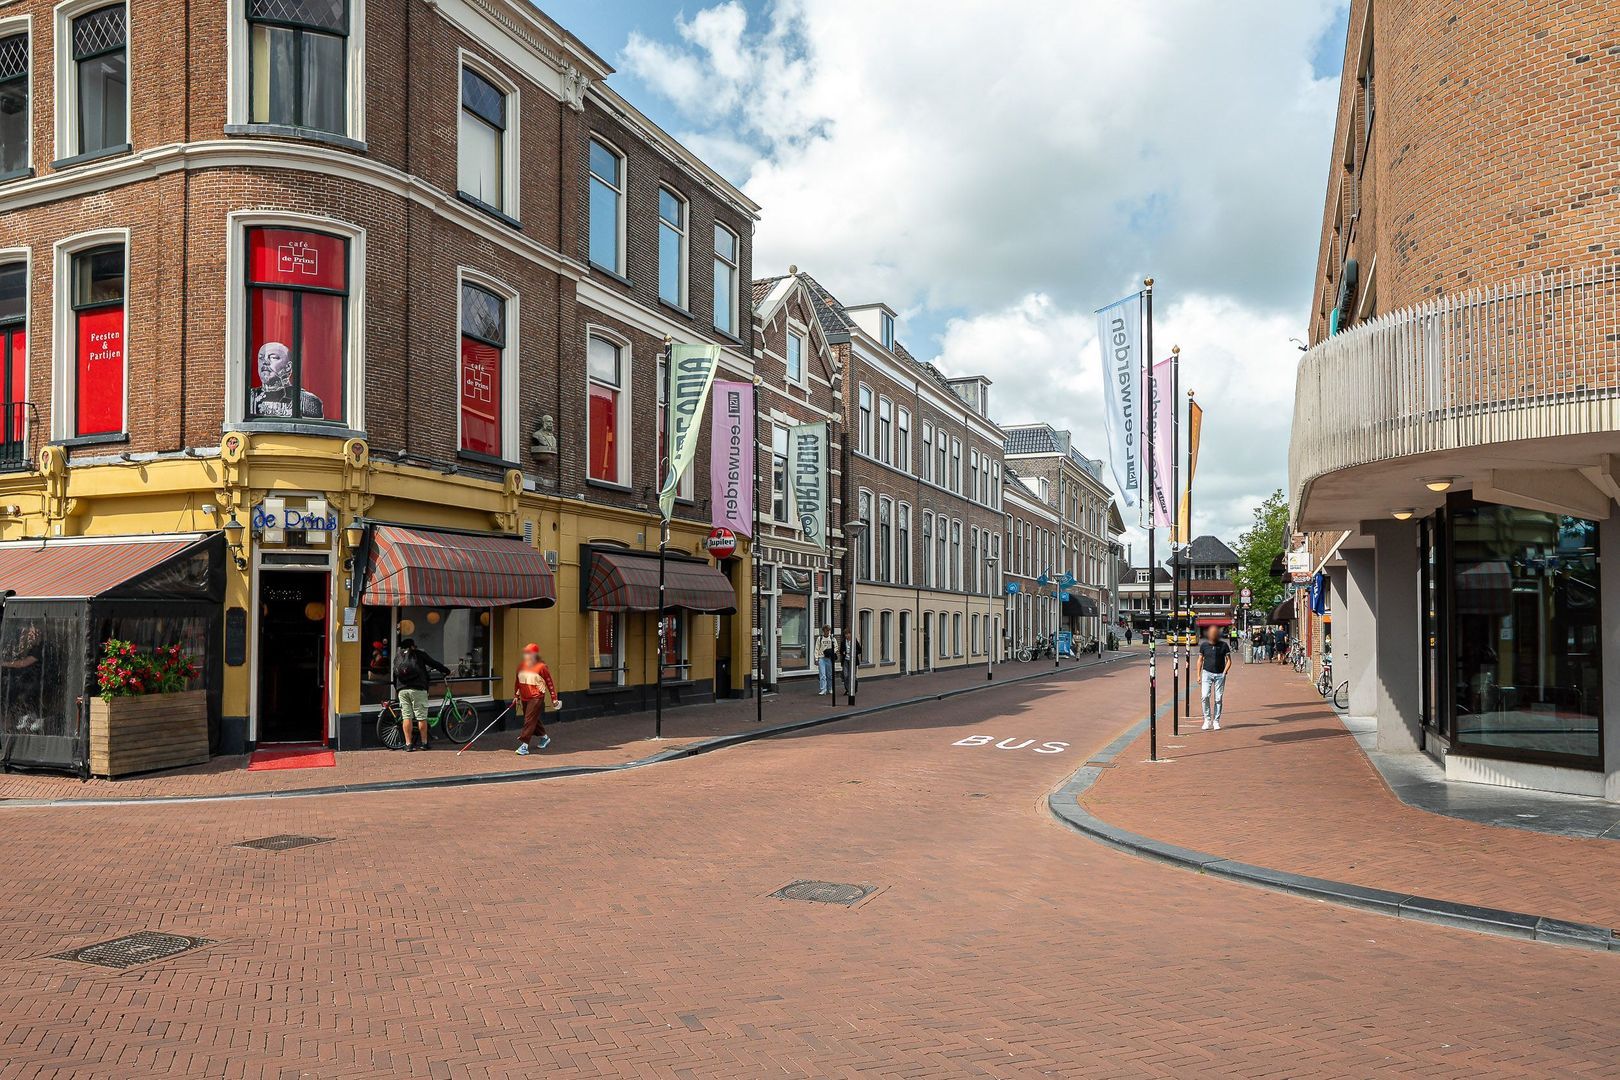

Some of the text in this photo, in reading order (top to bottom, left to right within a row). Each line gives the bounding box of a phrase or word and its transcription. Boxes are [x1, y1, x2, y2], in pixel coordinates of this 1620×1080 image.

[293, 256, 315, 264] Prins
[91, 331, 120, 342] Feesten
[102, 341, 108, 350] &
[89, 350, 121, 361] Partijen
[470, 363, 485, 372] café
[466, 379, 489, 391] de Prins
[253, 505, 337, 531] de Prins
[709, 538, 734, 548] Jupiler
[951, 735, 1071, 754] BUS
